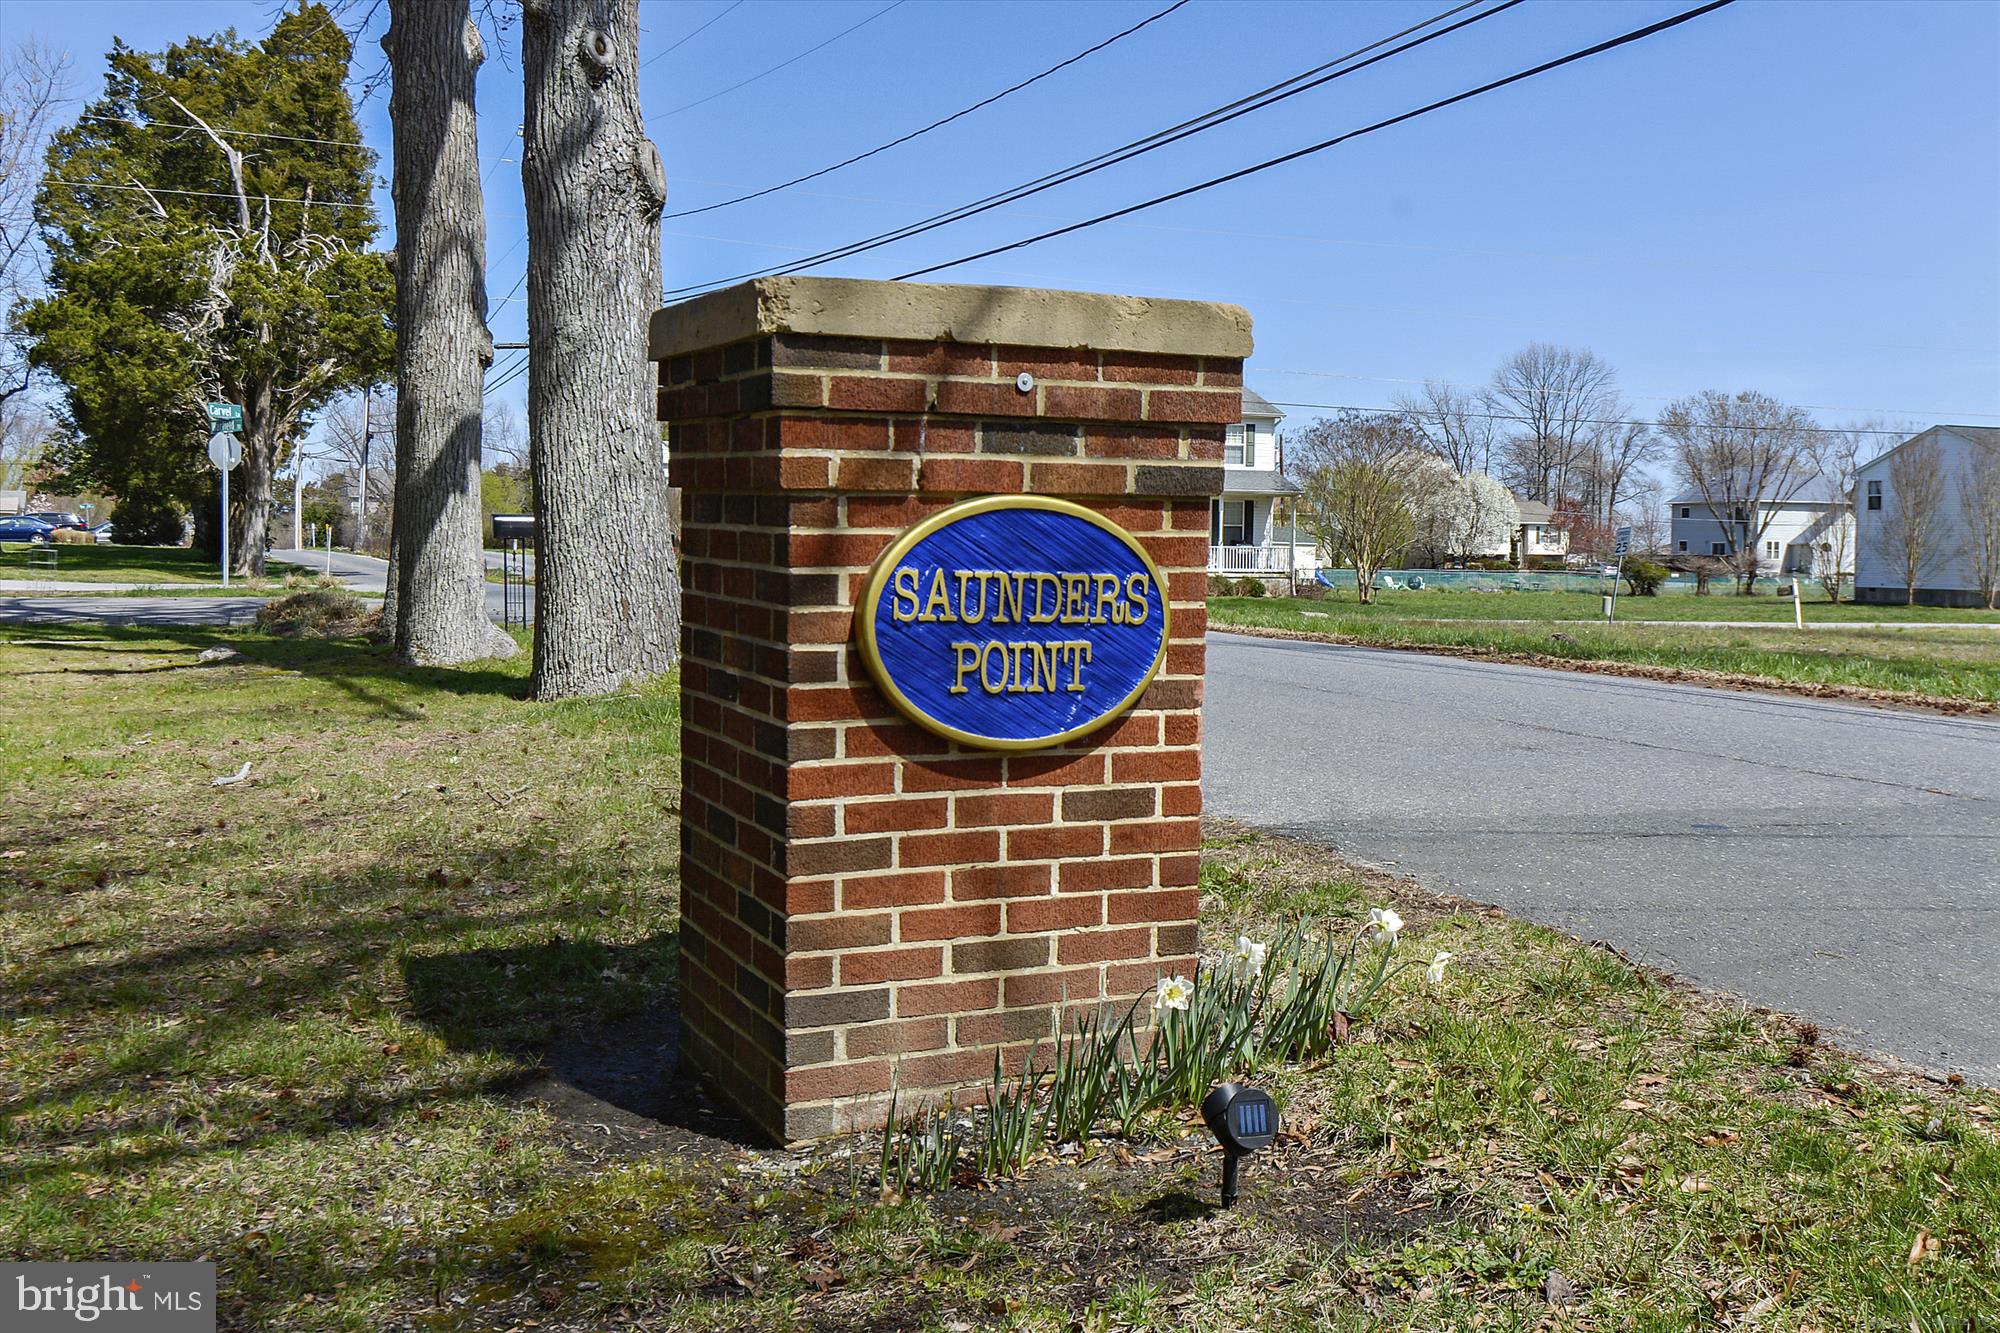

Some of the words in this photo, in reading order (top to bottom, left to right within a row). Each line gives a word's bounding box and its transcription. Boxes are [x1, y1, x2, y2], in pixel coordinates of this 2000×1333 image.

[209, 405, 232, 417] Carvel
[1615, 542, 1628, 553] 25
[892, 566, 1149, 625] SAUNDERS
[950, 640, 1092, 694] POINT
